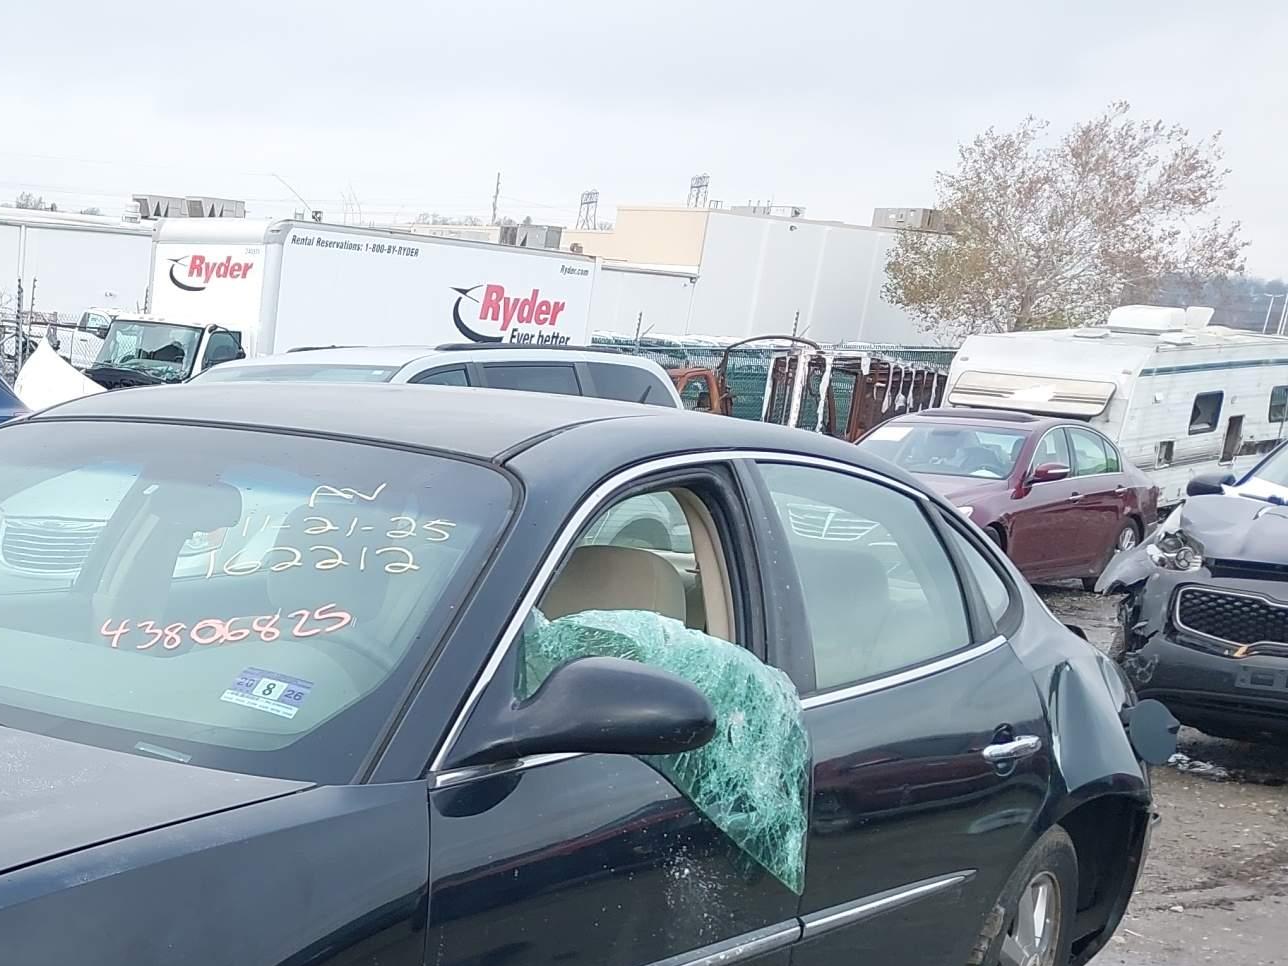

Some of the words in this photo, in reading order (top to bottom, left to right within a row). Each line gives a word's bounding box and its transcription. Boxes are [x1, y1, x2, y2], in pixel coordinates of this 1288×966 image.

[291, 234, 314, 246] Rental
[316, 236, 364, 252] Reservations:
[365, 243, 420, 258] 1-800-BY-RYDER
[188, 254, 254, 284] Ryder
[560, 265, 589, 276] Ryder.com
[479, 284, 565, 331] Ryder
[509, 328, 535, 344] Ever
[101, 602, 352, 649] 43806825
[262, 682, 276, 696] 8
[284, 689, 304, 701] 26
